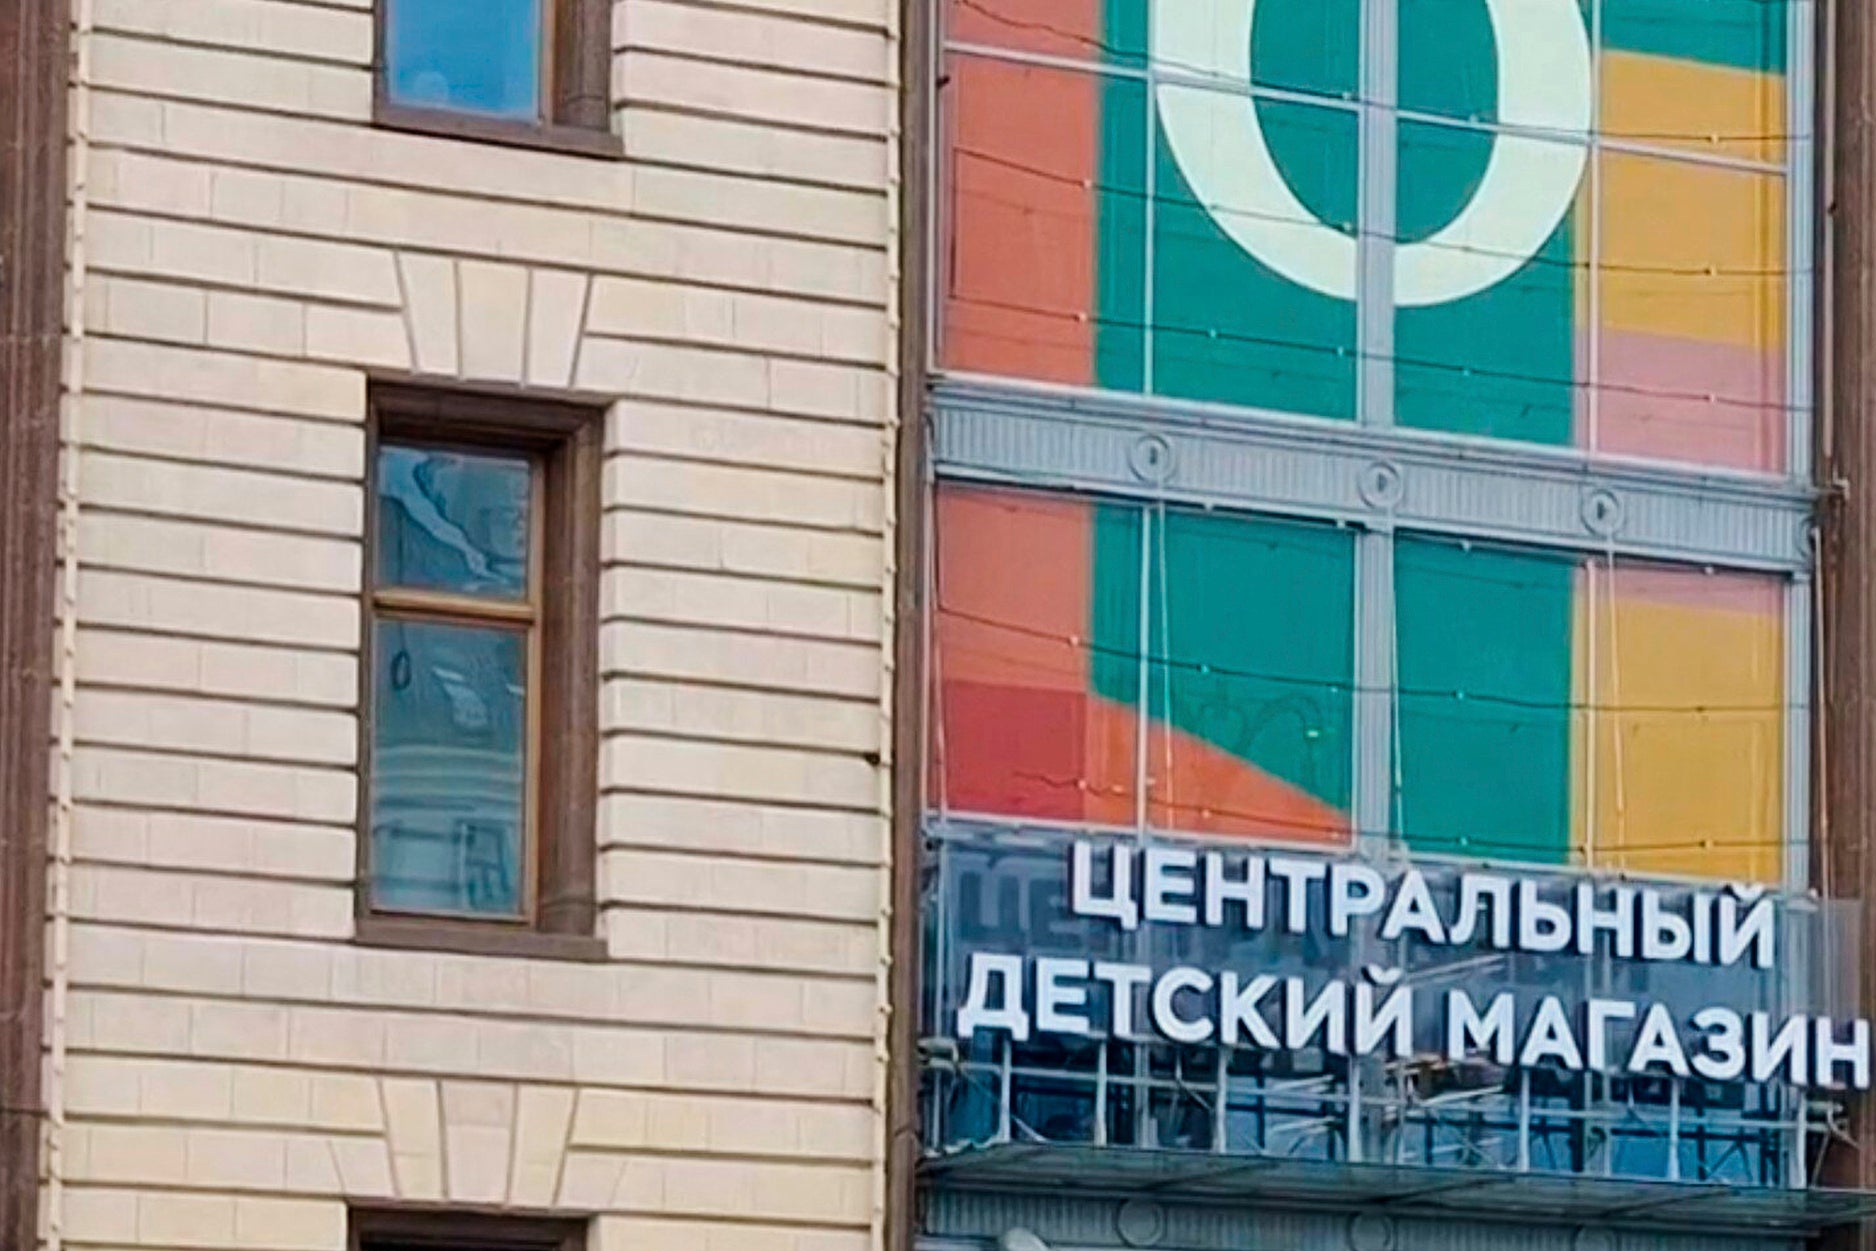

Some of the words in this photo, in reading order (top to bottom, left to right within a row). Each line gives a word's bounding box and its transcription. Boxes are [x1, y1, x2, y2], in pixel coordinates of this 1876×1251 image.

[1070, 839, 1776, 970] ЦЕНТРАЛЬНЫЙ
[956, 953, 1414, 1058] ДЕТСКИЙ
[1446, 990, 1872, 1092] МАГАЗИН
